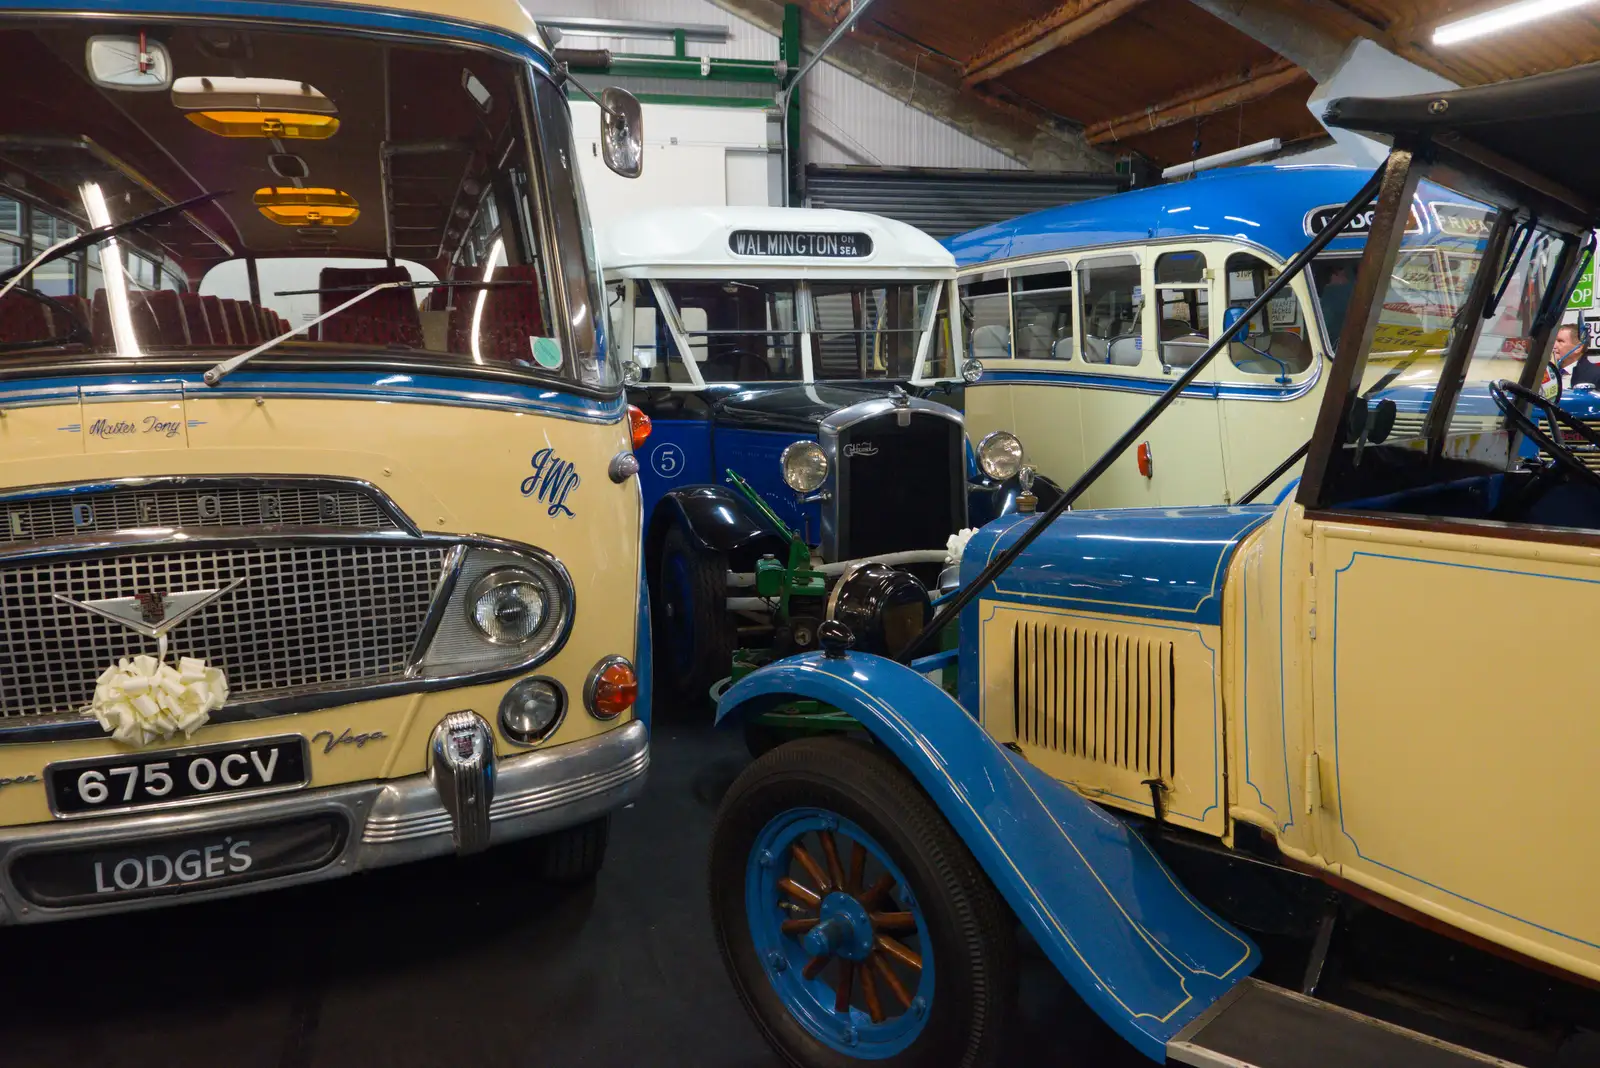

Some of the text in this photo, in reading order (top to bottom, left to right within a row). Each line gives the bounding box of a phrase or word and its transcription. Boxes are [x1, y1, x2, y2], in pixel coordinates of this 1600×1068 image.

[736, 234, 838, 255] WALMINGTON
[839, 246, 858, 255] SEA
[841, 235, 855, 243] ON
[88, 415, 182, 439] Master Tony
[660, 450, 676, 471] 5
[9, 494, 338, 536] EDFORD
[311, 727, 389, 754] Vega
[78, 748, 279, 803] 675 OCV
[94, 837, 253, 893] LODGE'S
